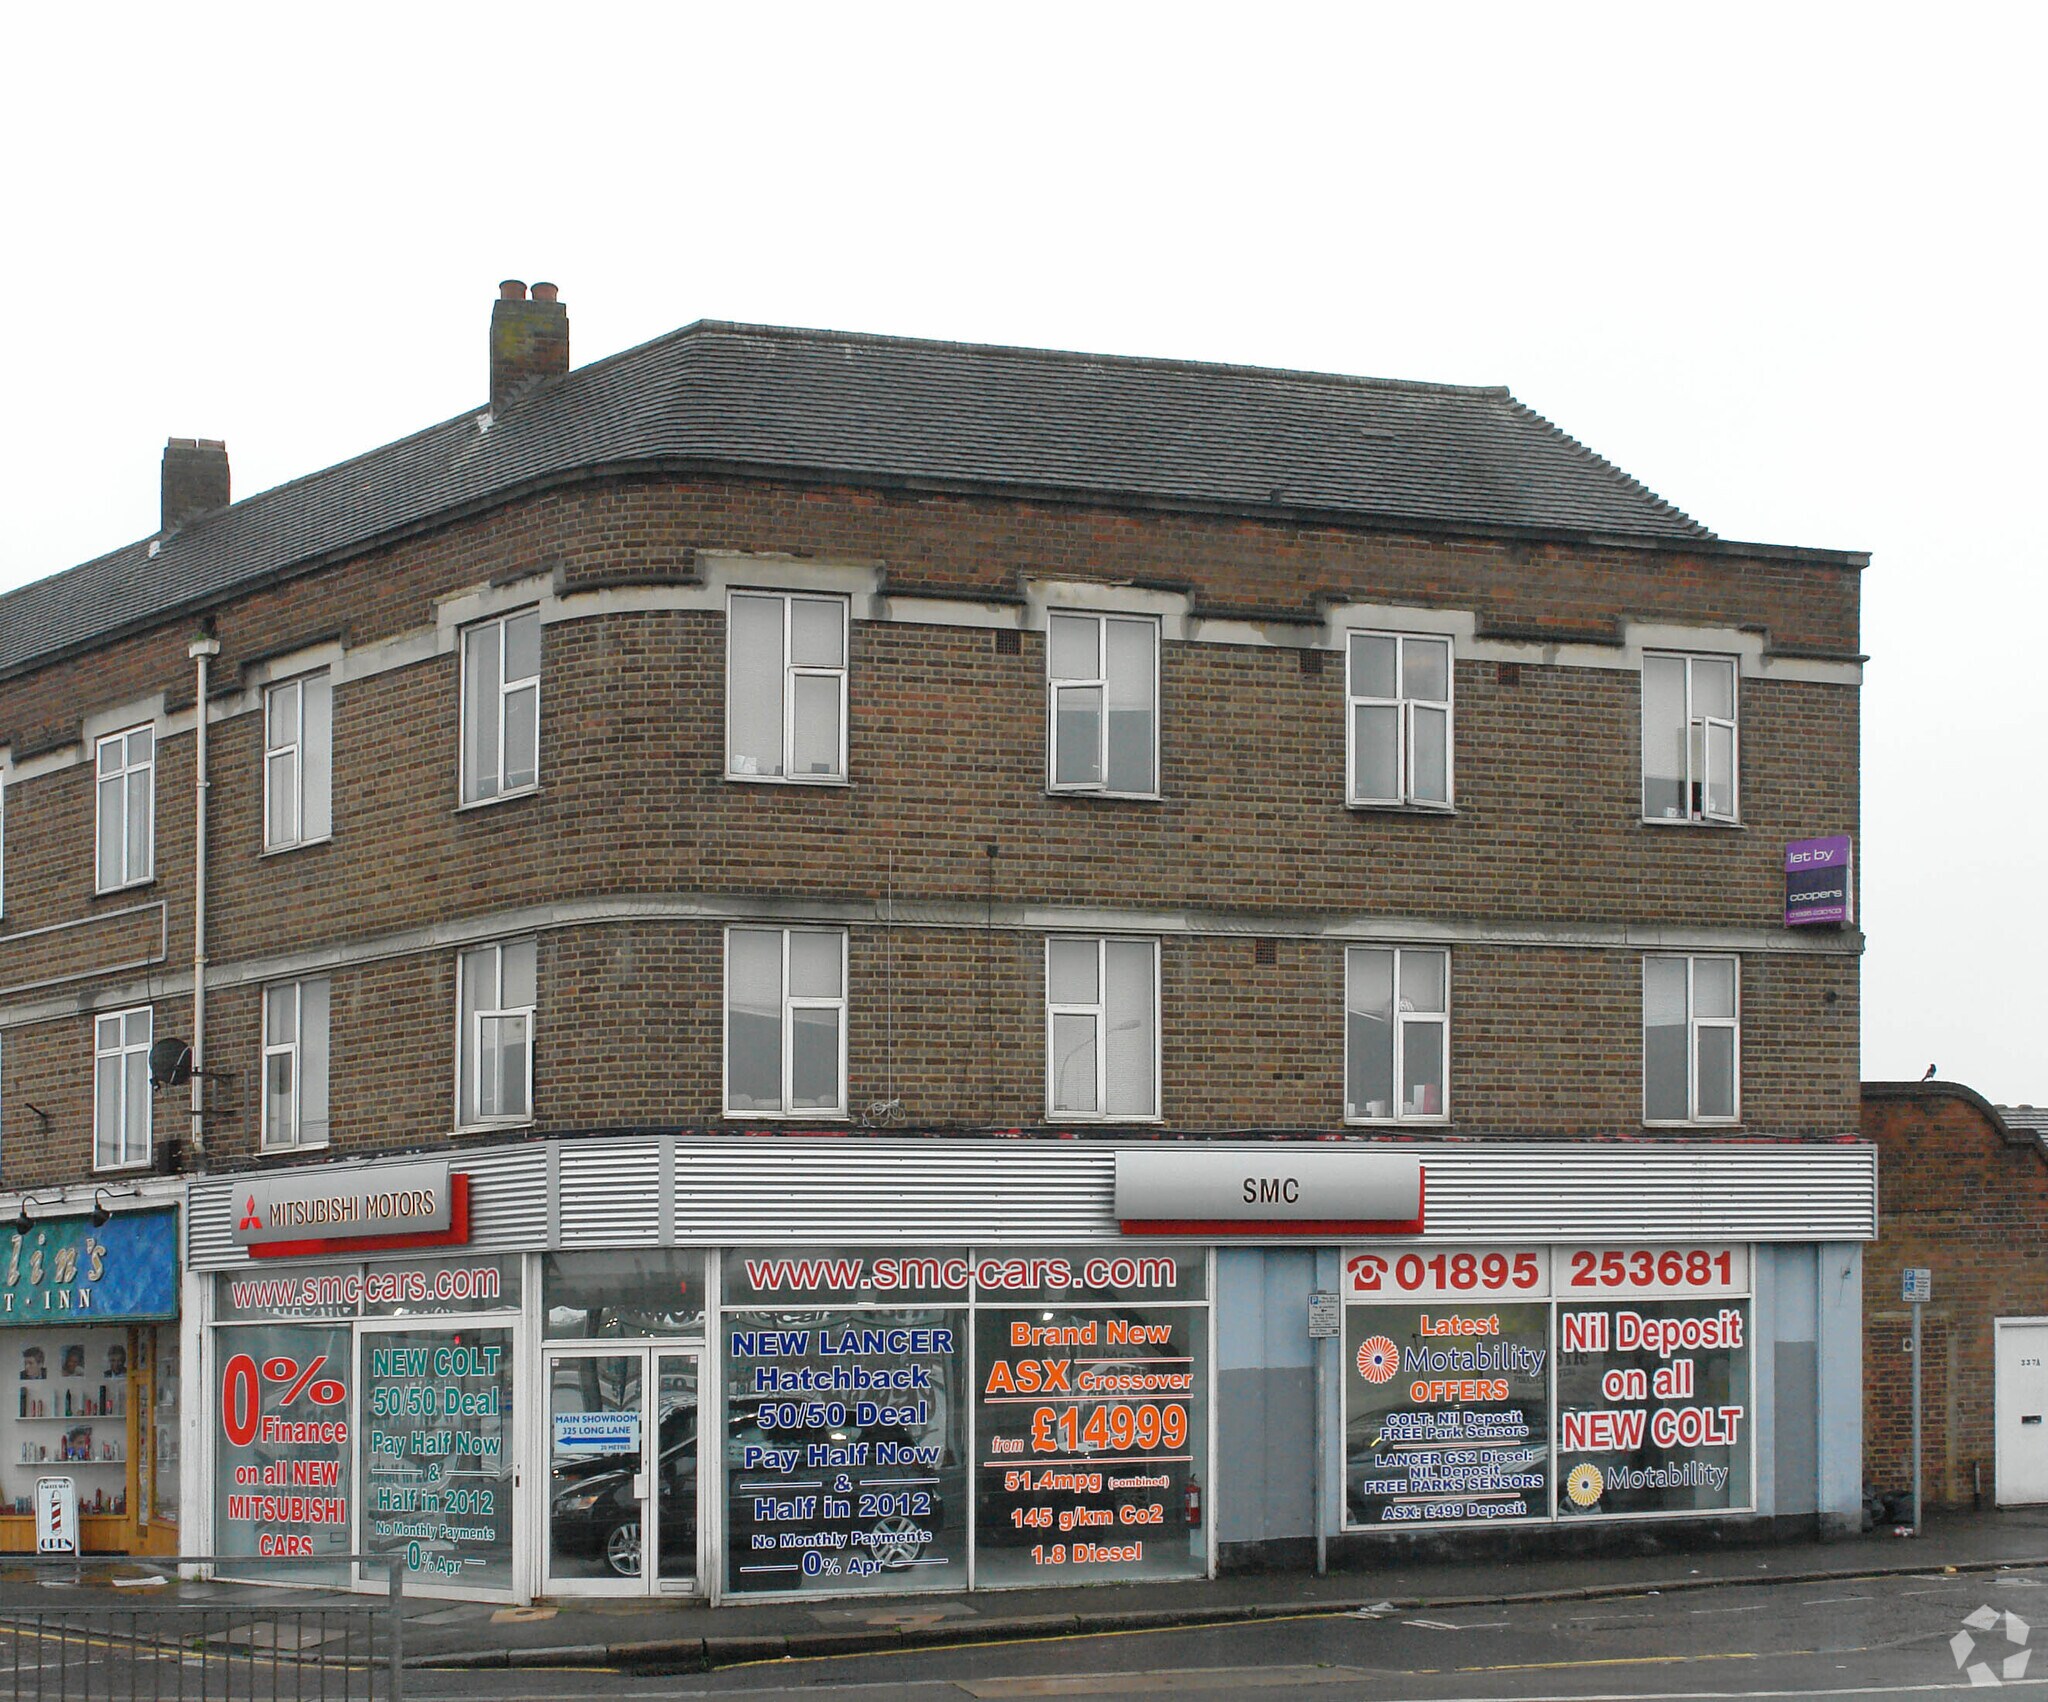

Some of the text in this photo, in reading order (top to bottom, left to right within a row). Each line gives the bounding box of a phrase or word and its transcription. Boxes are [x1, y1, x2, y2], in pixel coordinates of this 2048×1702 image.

[1790, 850, 1834, 863] let by
[1790, 890, 1842, 902] coopers
[1242, 1177, 1300, 1204] SMC
[270, 1189, 436, 1227] MITSUBISHI MOTORS
[744, 1256, 1178, 1292] www.smc-cars.com
[1395, 1250, 1731, 1292] 01895 253681
[45, 1288, 91, 1309] INN
[232, 1267, 500, 1309] www.smc-cars.com
[1010, 1320, 1172, 1346] Brand New
[1420, 1314, 1500, 1336] Latest
[1563, 1309, 1743, 1358] Nil Deposit
[732, 1329, 954, 1357] NEW LANCER
[373, 1347, 501, 1377] NEW COLT
[1404, 1342, 1546, 1377] Motability
[755, 1364, 931, 1392] Hatchback
[985, 1359, 1194, 1393] ASX Crossover
[1602, 1359, 1694, 1401] on all
[222, 1354, 346, 1447] 0%
[374, 1386, 499, 1416] 50/50 Deal
[1410, 1378, 1509, 1403] OFFERS
[556, 1415, 638, 1424] MAIN SHOWROOM
[757, 1400, 928, 1429] 50/50 Deal
[1386, 1410, 1523, 1427] COLT: Nil Deposit
[262, 1416, 347, 1444] Finance
[562, 1426, 630, 1435] 325 LONG LANE
[992, 1404, 1187, 1453] from £14999
[1380, 1424, 1529, 1441] FREE Park Sensors
[1562, 1406, 1744, 1452] NEW COLT
[372, 1431, 501, 1459] Pay Half Now
[744, 1442, 941, 1473] Pay Half Now
[1376, 1450, 1533, 1468] LANCER GS2 Diesel:
[1409, 1464, 1500, 1480] NIL Deposit
[236, 1465, 258, 1485] on
[264, 1460, 287, 1486] all
[293, 1461, 340, 1487] NEW
[428, 1463, 441, 1483] &
[834, 1475, 853, 1493] &
[1004, 1470, 1170, 1493] 51.4mpg (combined)
[1364, 1474, 1544, 1494] FREE PARKS SENSORS
[1607, 1461, 1728, 1491] Motability
[228, 1495, 346, 1524] MITSUBISHI
[378, 1487, 494, 1515] Half in 2012
[754, 1493, 931, 1521] Half in 2012
[1382, 1502, 1526, 1520] ASX: £499 Deposit
[1011, 1503, 1163, 1531] 145 g/km Co2
[41, 1538, 72, 1549] OPEN
[376, 1521, 495, 1541] No Monthly Payments
[752, 1530, 932, 1549] No Monthly Payments
[260, 1533, 313, 1557] CARS
[407, 1540, 461, 1577] 0% Apr
[1031, 1542, 1142, 1565] 1.8 Diesel
[802, 1551, 884, 1576] 0% Apr
